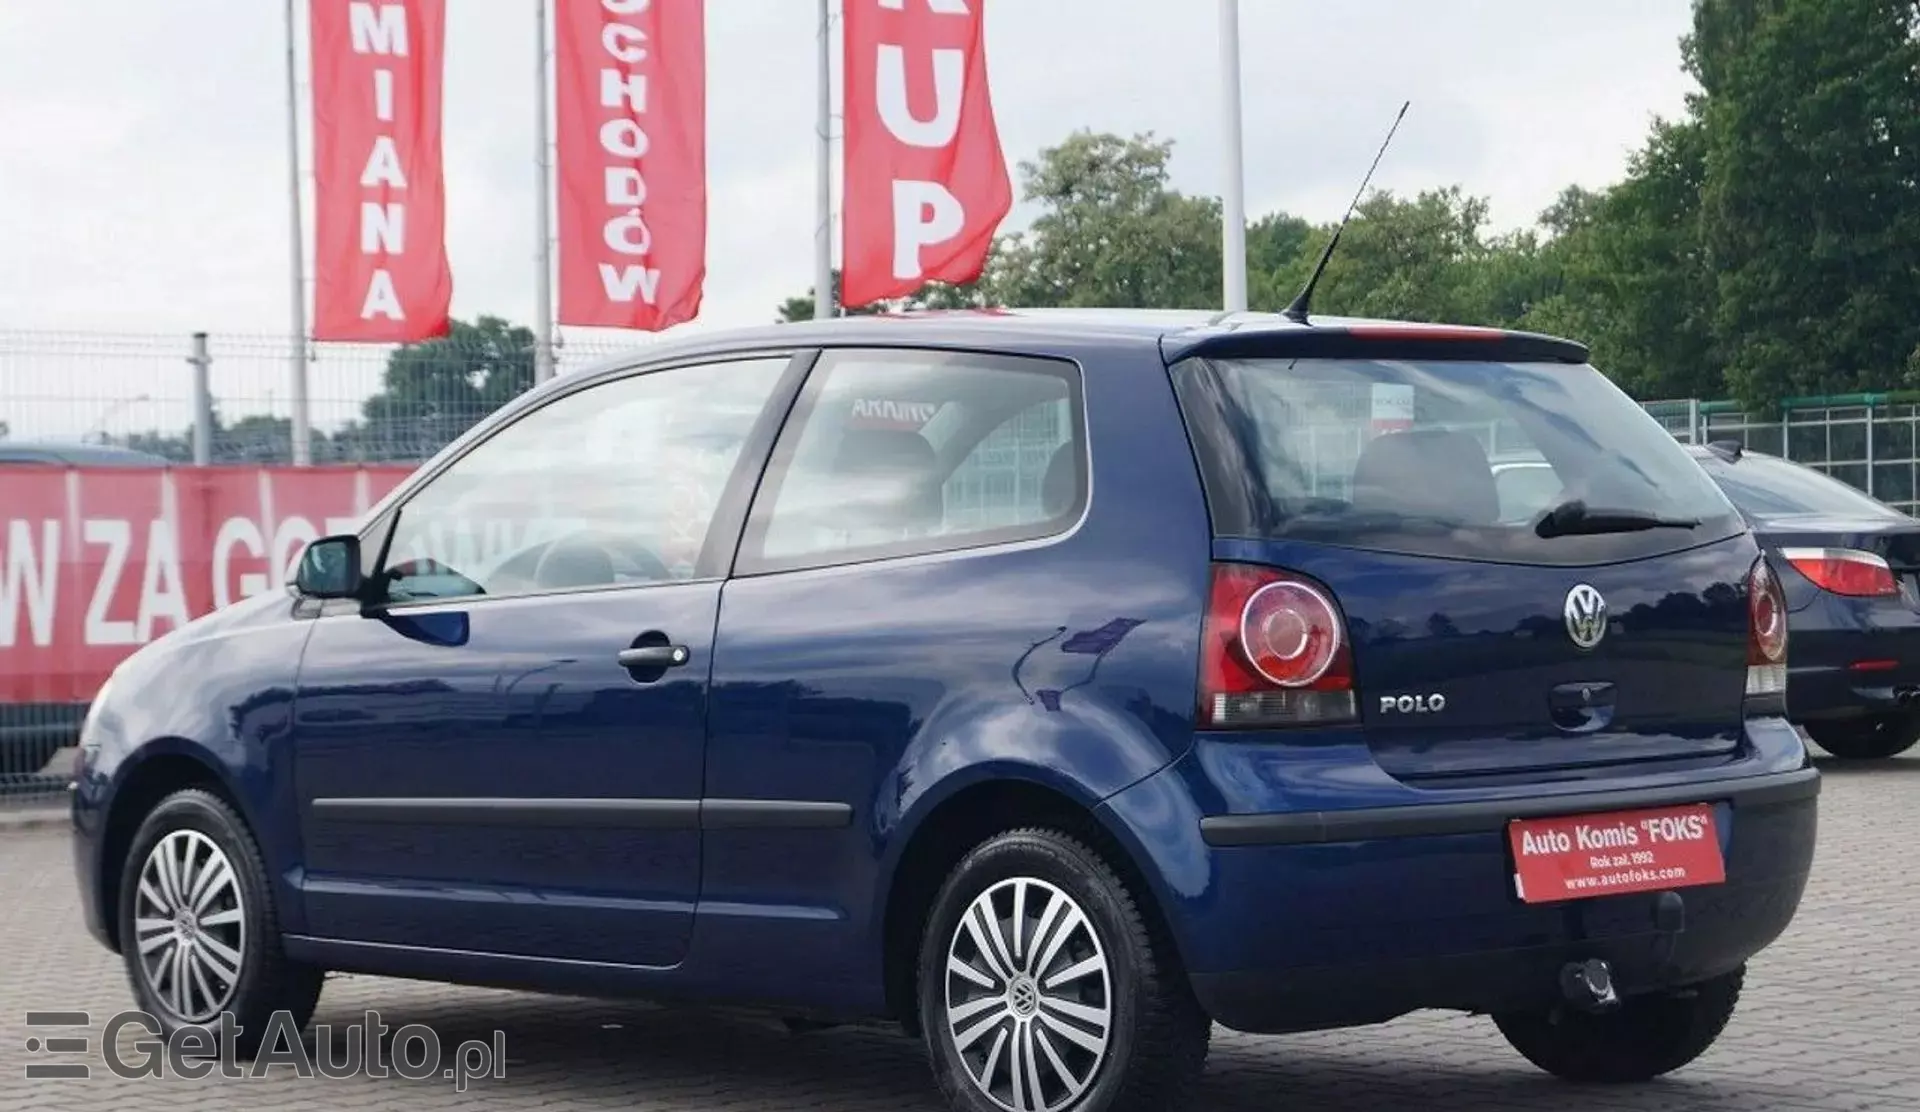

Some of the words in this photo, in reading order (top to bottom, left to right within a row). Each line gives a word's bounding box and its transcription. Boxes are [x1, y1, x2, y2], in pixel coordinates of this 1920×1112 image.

[876, 0, 970, 280] UP
[83, 518, 192, 645] ZA
[1379, 693, 1446, 713] POLO
[1522, 830, 1571, 856] Auto
[1575, 822, 1639, 850] Komis
[1589, 855, 1612, 868] Rok
[1631, 850, 1656, 865] 1992
[1564, 866, 1686, 890] www.autofoks.com
